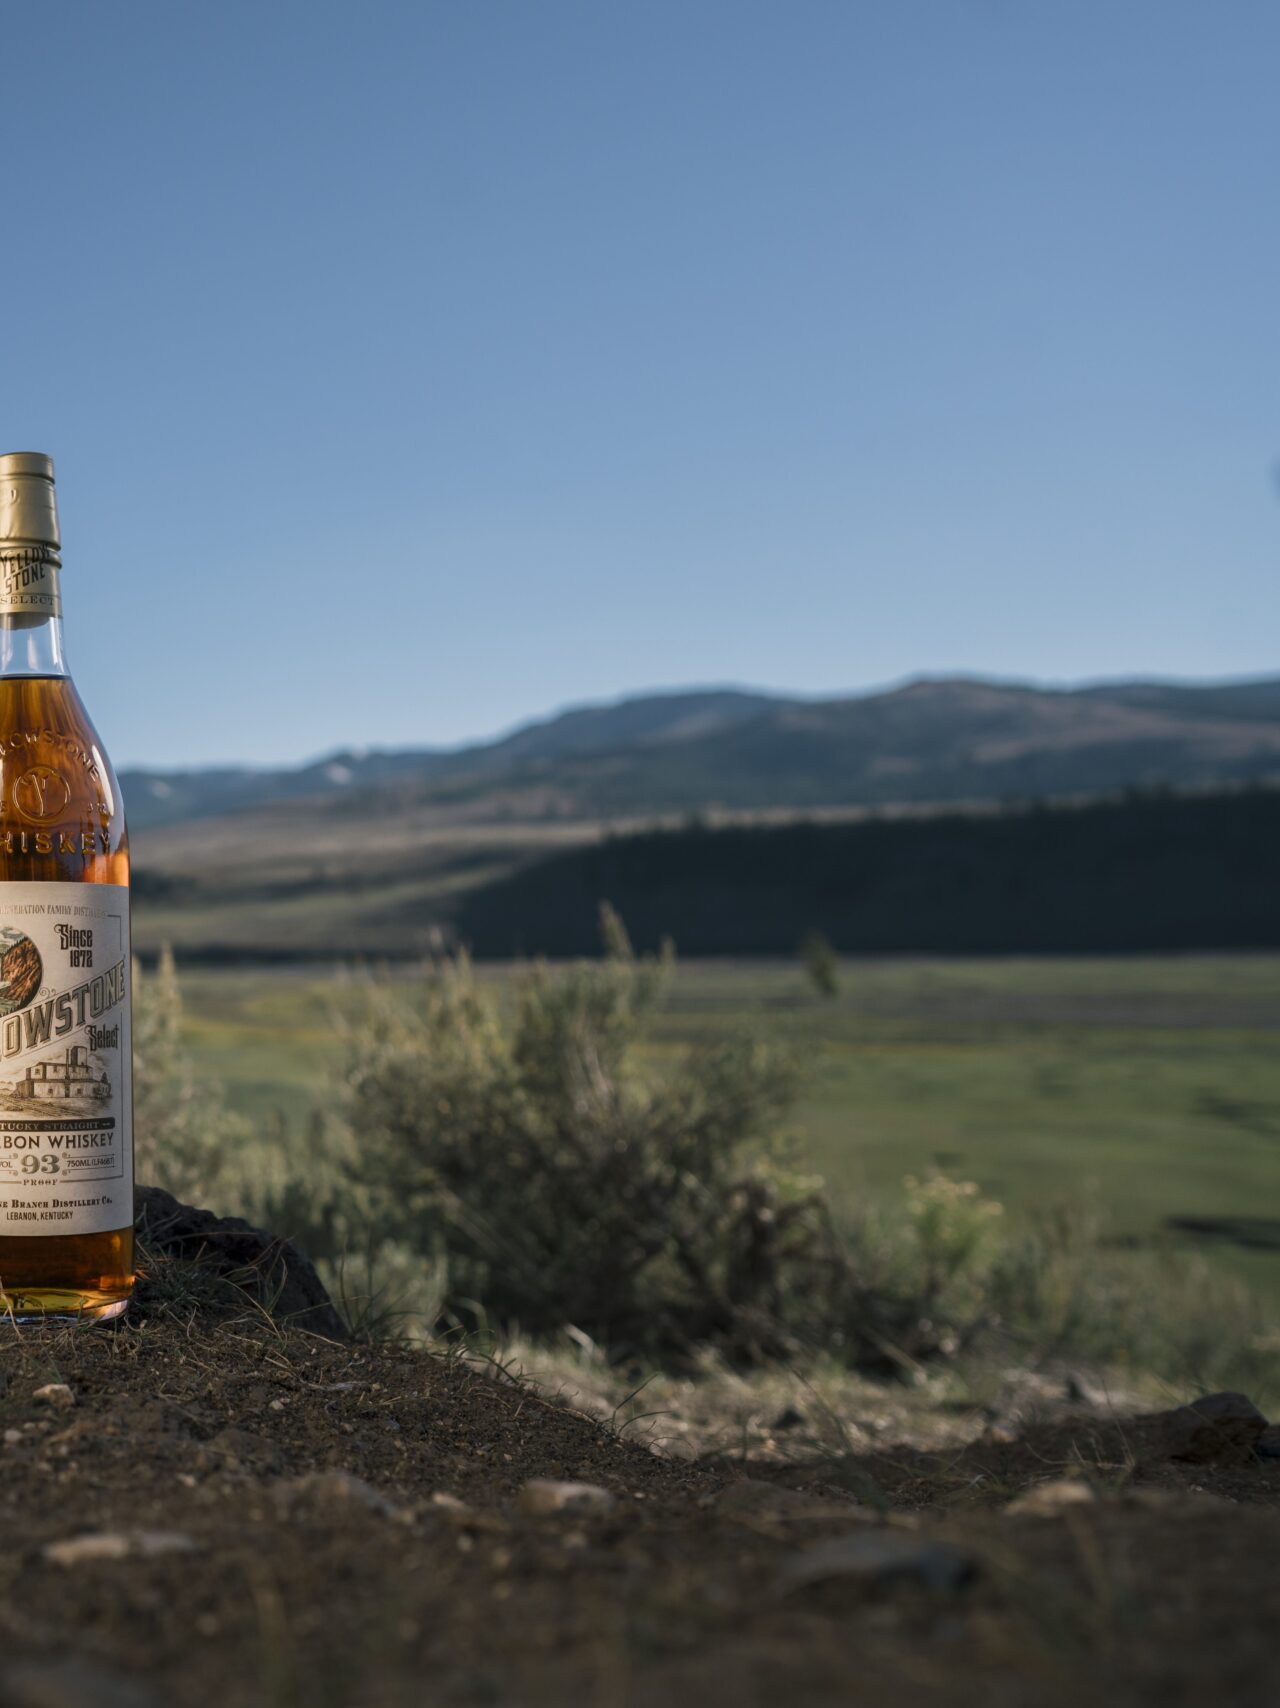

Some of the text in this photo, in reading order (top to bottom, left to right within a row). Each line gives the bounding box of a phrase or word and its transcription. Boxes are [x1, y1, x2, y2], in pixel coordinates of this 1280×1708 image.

[6, 561, 46, 595] STONE
[0, 595, 54, 606] SELECT
[0, 904, 45, 915] EERATION
[47, 904, 72, 915] FAMILY
[54, 923, 93, 951] Since
[70, 950, 93, 968] 1872
[84, 1024, 119, 1051] Select
[44, 1121, 100, 1130] STRAIGHT
[48, 1132, 114, 1149] WHISKEY
[21, 1154, 60, 1175] 93
[67, 1159, 91, 1167] 750ML
[23, 1178, 58, 1186] PROOF
[11, 1199, 49, 1209] BRANCH
[52, 1198, 100, 1209] DISTILLERY
[6, 1210, 73, 1222] LEBANON, KENTUCKY
